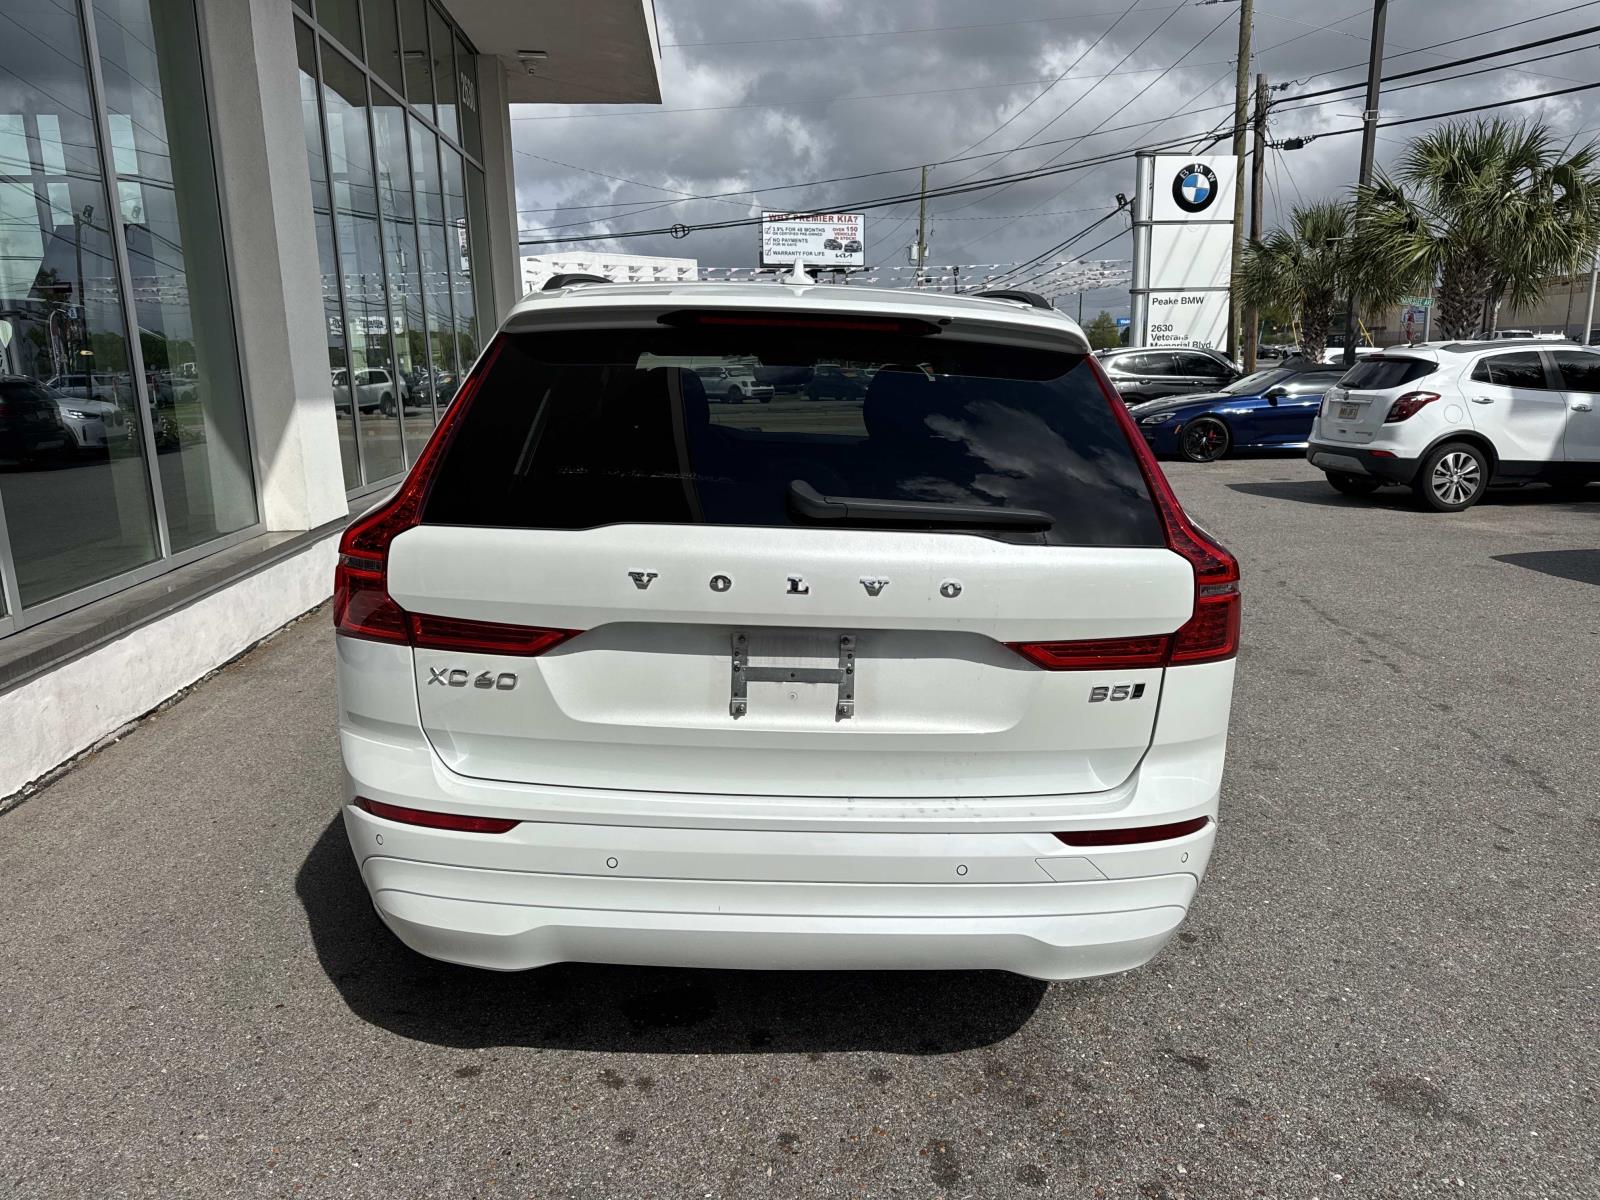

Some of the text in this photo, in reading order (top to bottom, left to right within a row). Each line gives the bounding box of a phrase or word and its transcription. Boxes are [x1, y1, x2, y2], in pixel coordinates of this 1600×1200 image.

[461, 71, 476, 112] 2630
[837, 215, 858, 223] KIA?
[1152, 296, 1204, 306] Peake BMW
[1151, 324, 1173, 332] 2630
[1192, 341, 1214, 349] Blvd.
[628, 571, 962, 598] VOLVO
